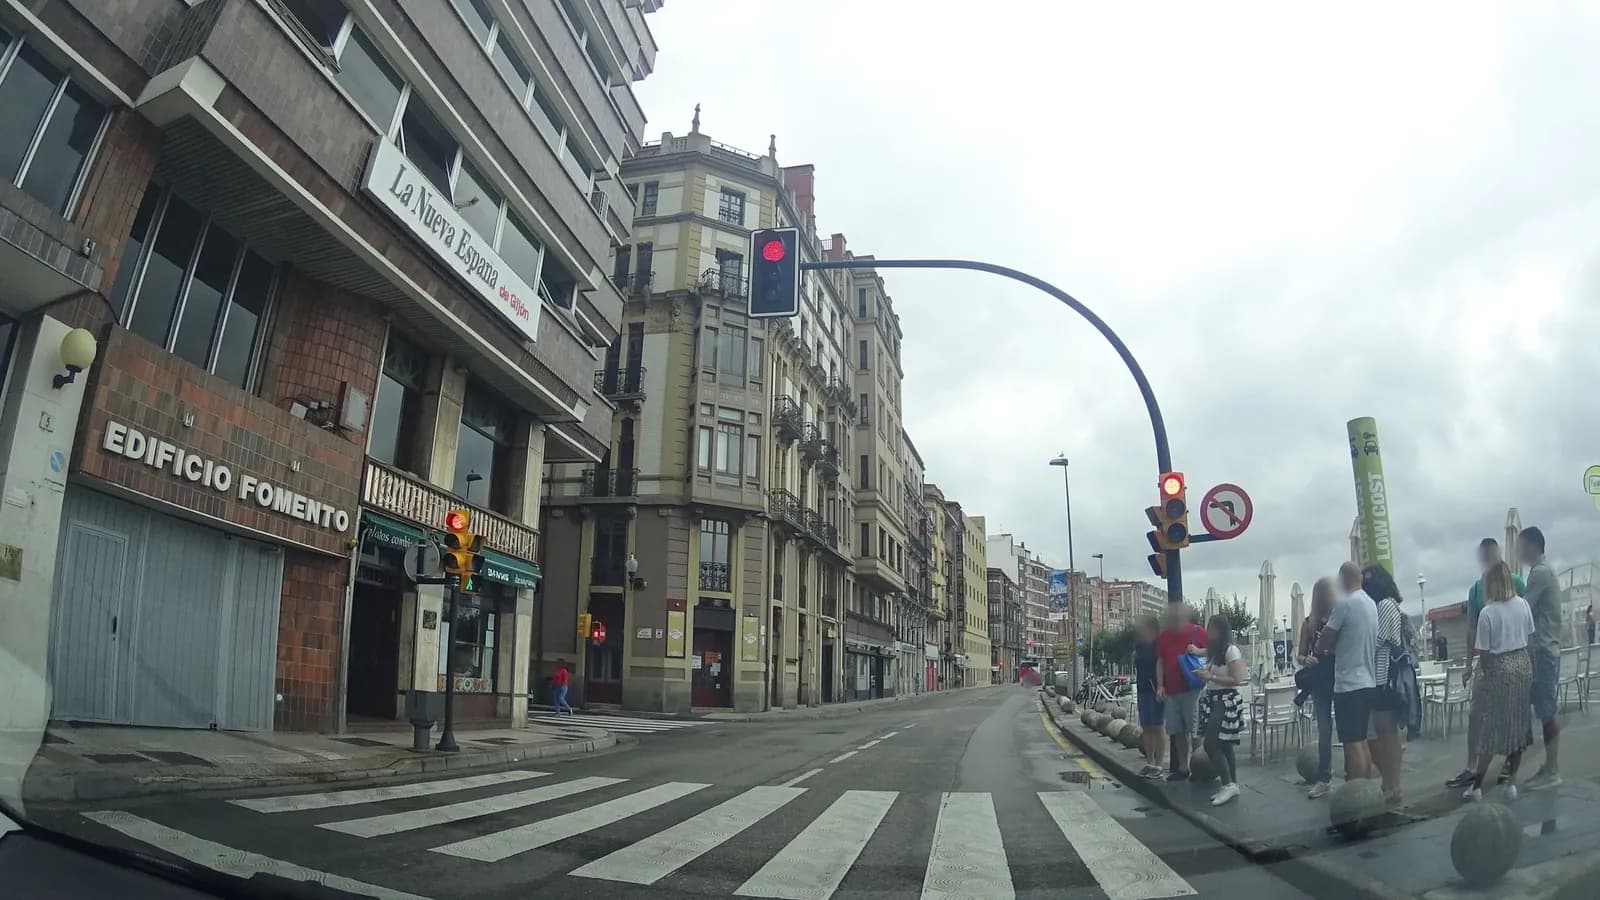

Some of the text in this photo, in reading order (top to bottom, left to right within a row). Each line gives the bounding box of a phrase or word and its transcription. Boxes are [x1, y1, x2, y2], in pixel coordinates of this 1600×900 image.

[389, 164, 414, 207] La
[411, 186, 457, 248] Nueva
[499, 285, 510, 301] de
[510, 294, 529, 321] Gijón
[103, 420, 349, 532] EDIFICIO FOMENTO
[1367, 472, 1391, 560] LOW COST
